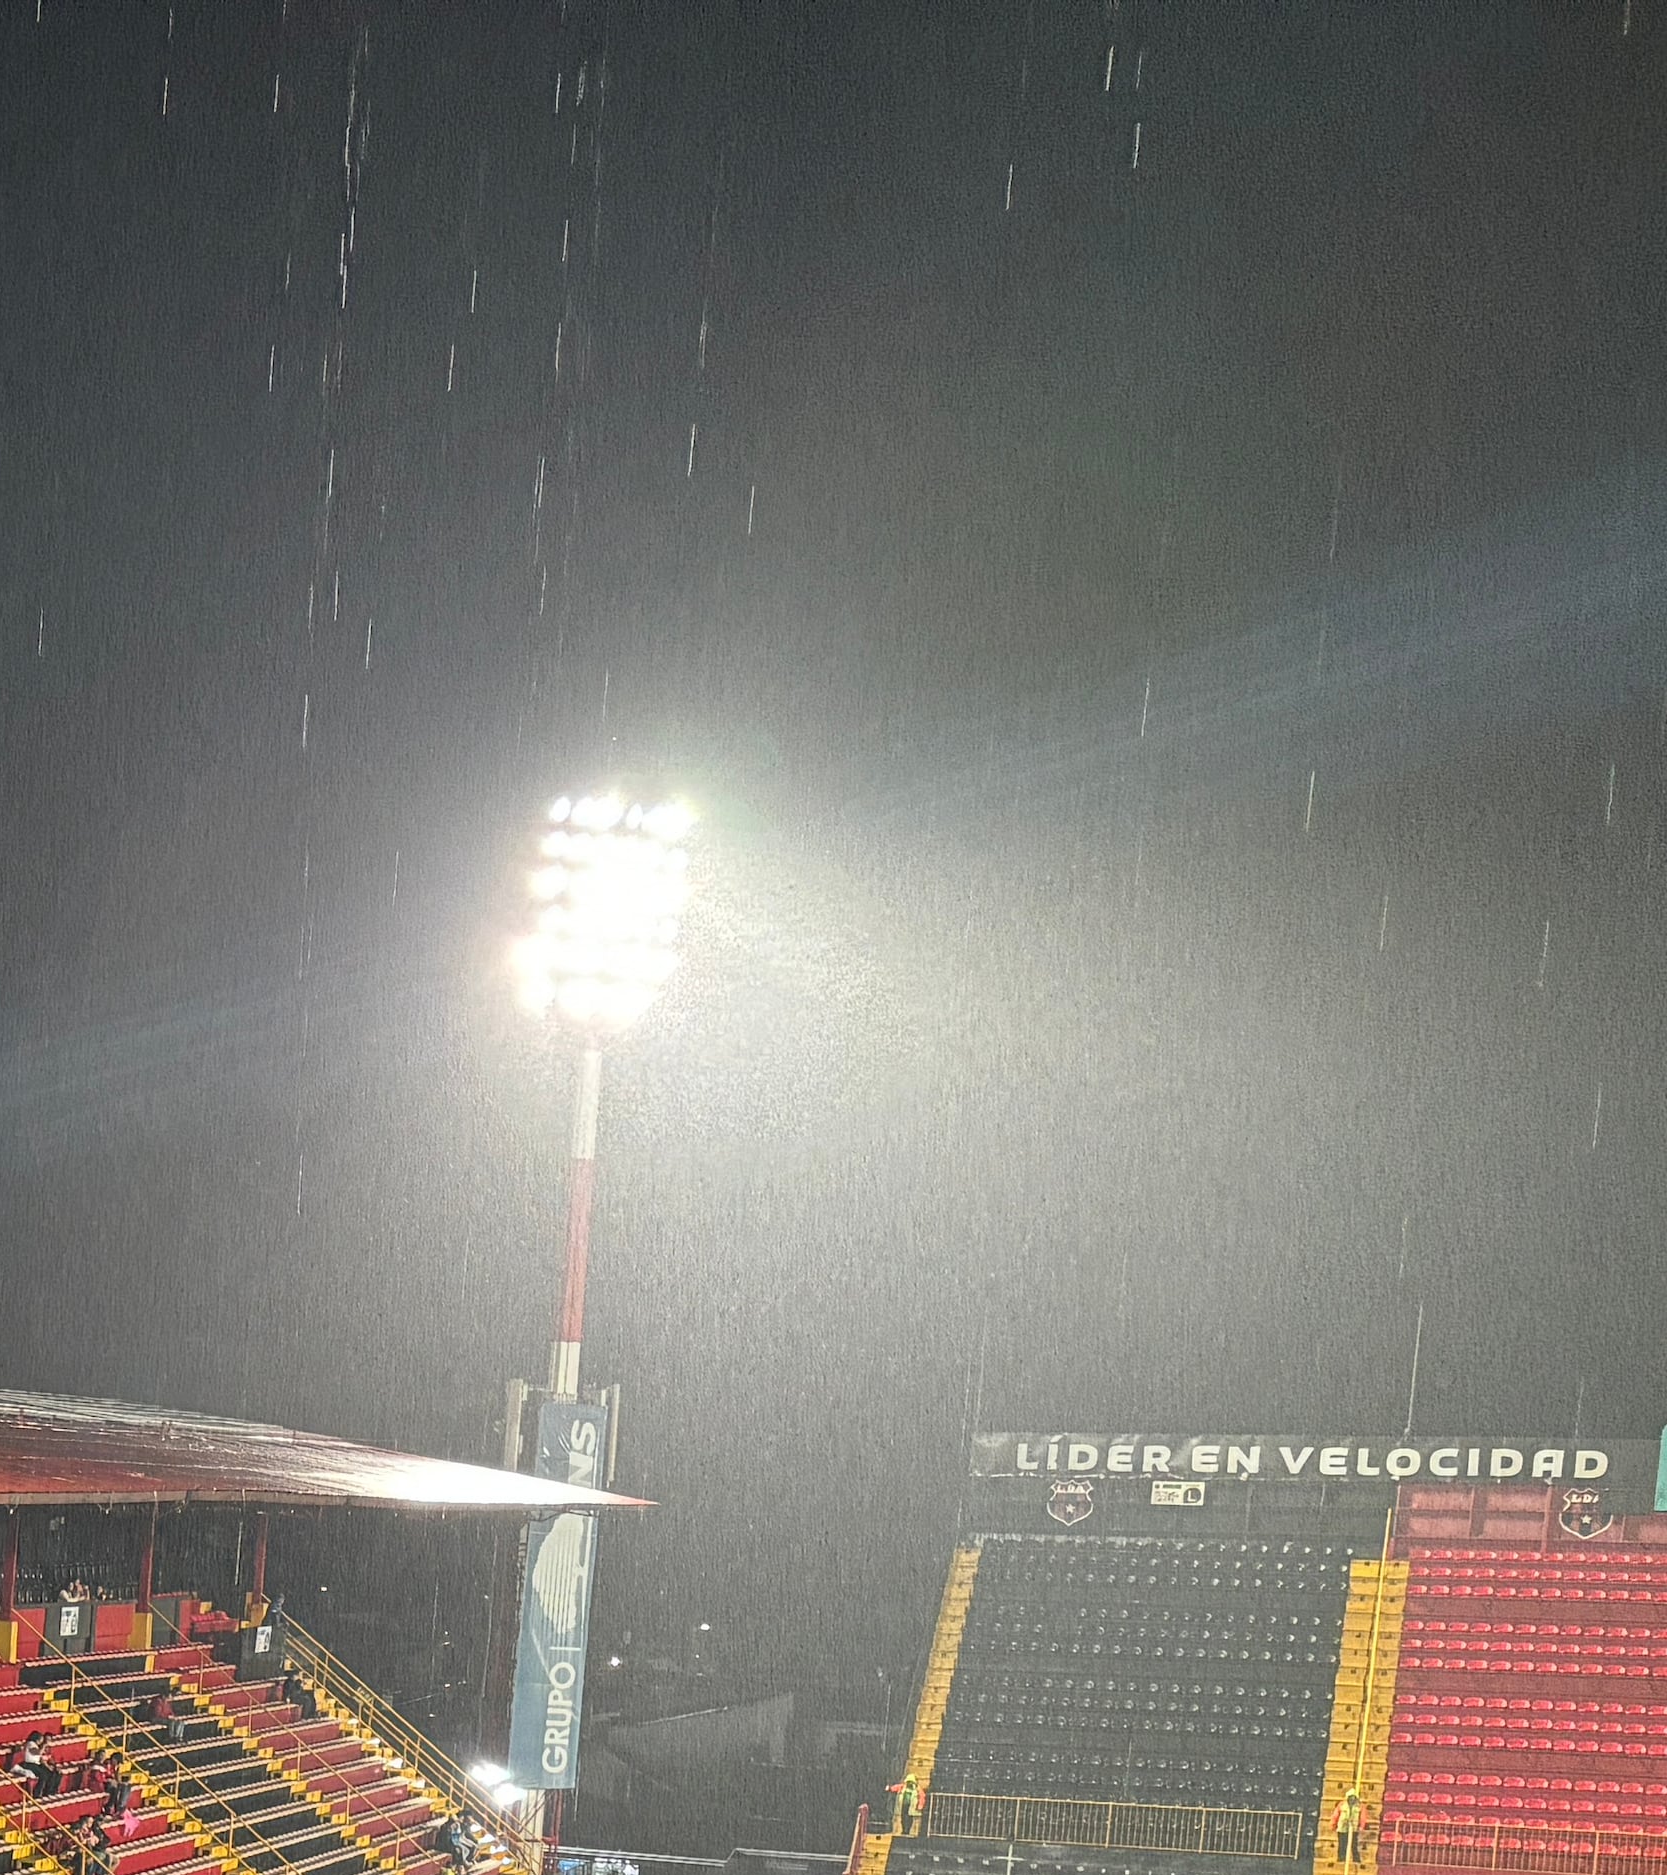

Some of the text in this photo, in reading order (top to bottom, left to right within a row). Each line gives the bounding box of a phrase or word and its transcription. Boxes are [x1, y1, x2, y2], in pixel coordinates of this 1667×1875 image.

[1017, 1433, 1609, 1479] LÍDER EN VELOCIDAD
[541, 1661, 576, 1774] GRUPO
